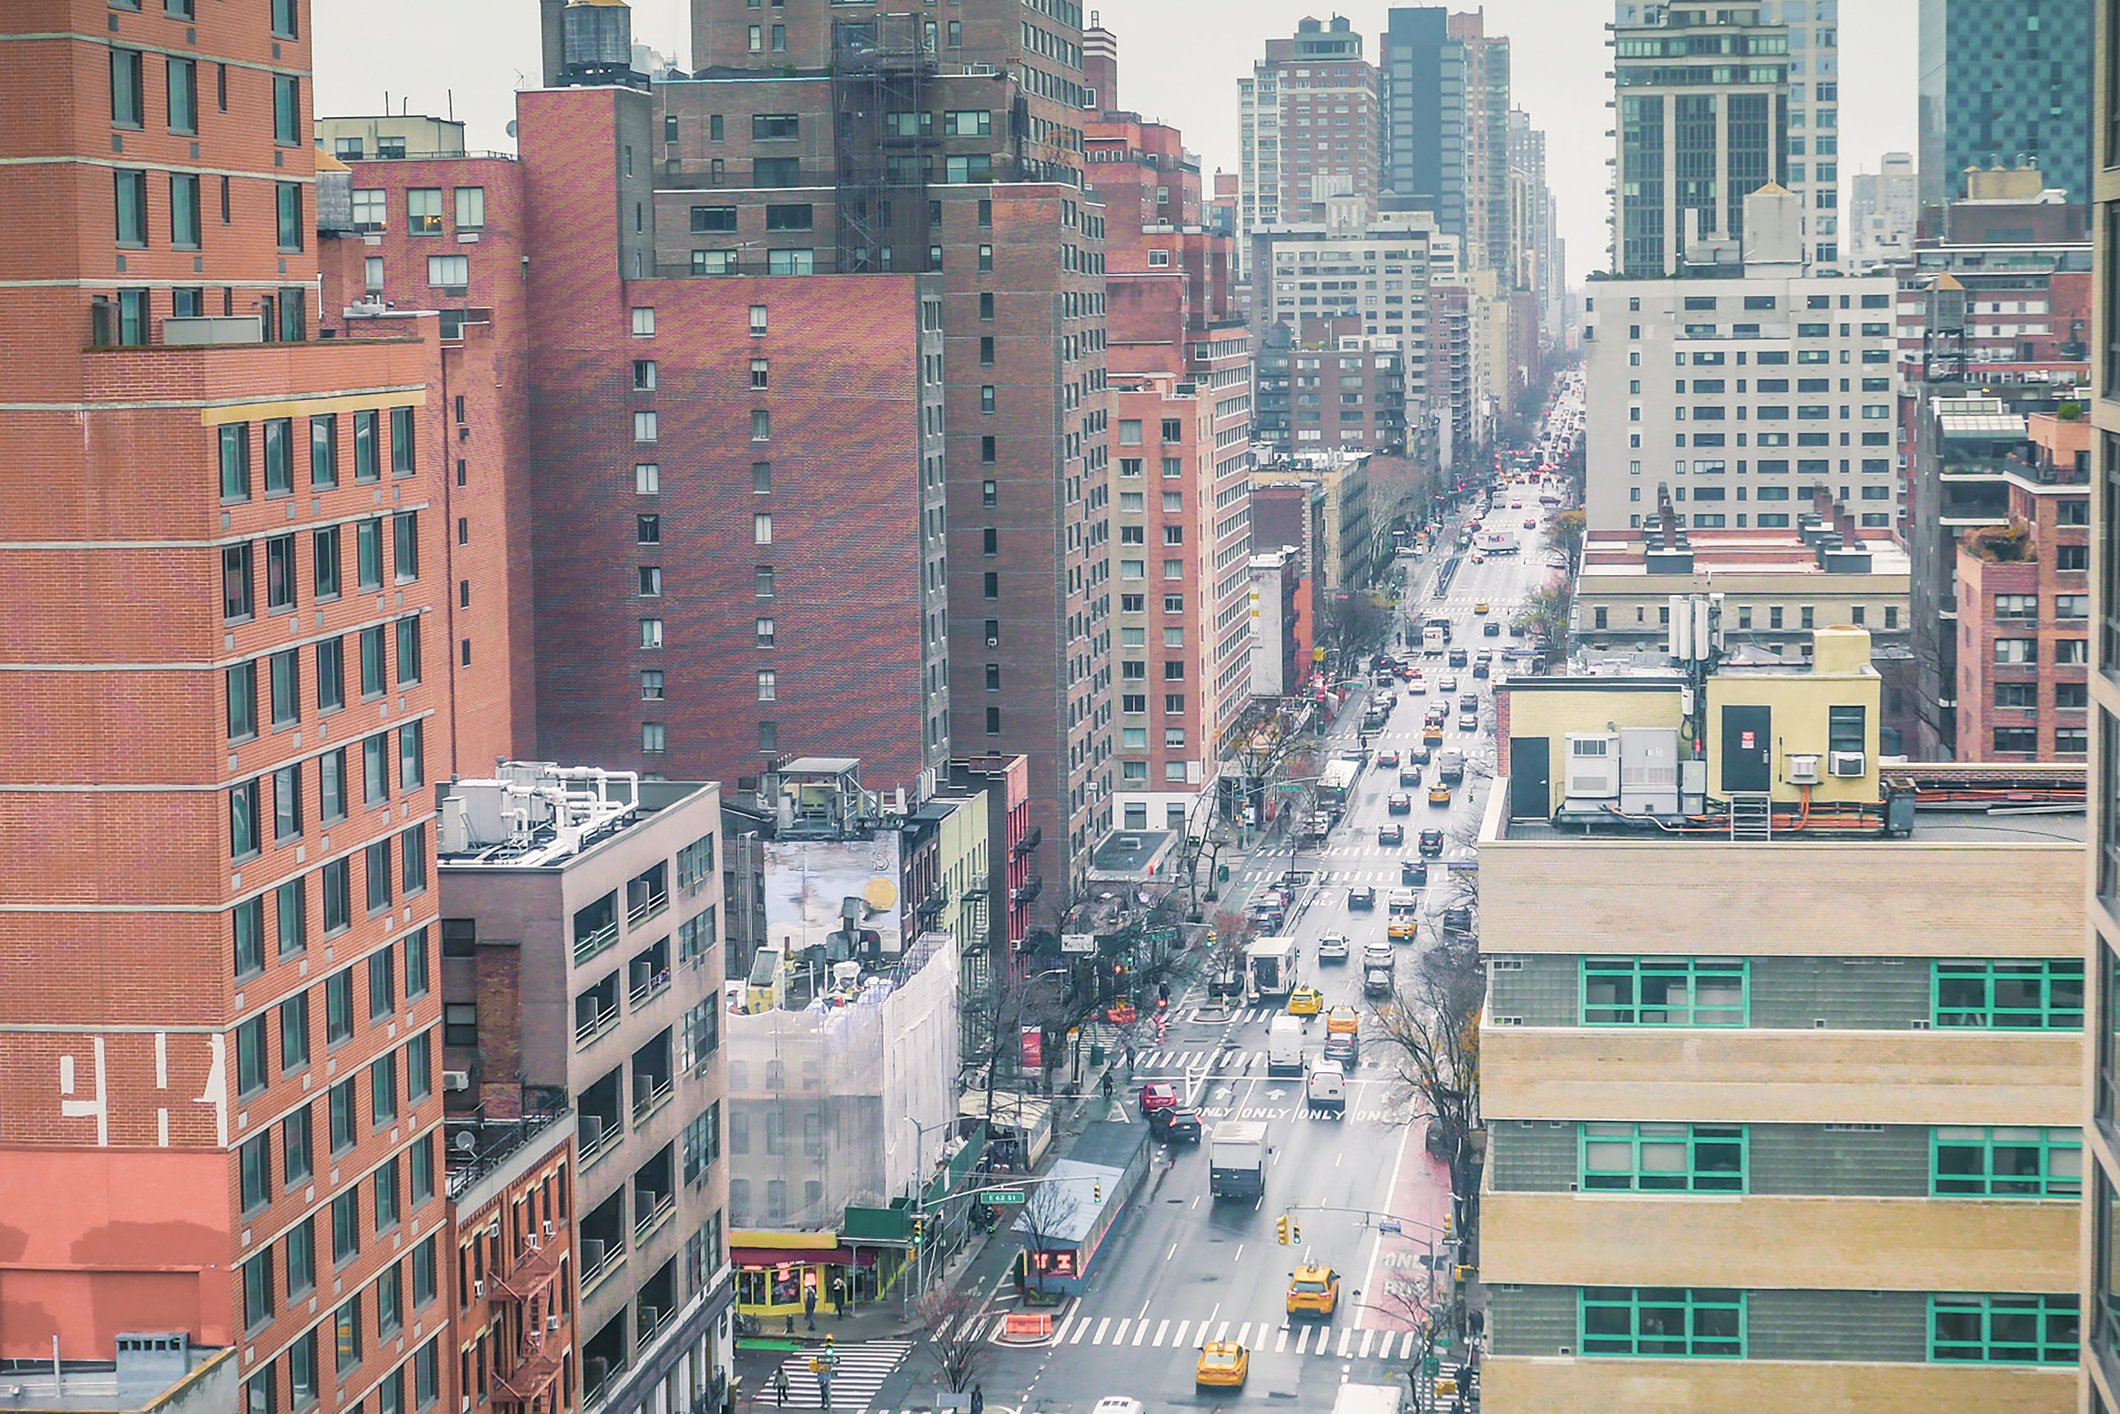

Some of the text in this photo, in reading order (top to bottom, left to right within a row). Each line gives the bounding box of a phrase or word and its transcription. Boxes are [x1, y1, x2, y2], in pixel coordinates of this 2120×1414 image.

[1193, 1107, 1234, 1117] ONLY
[1241, 1108, 1291, 1119] ONLY
[1298, 1108, 1346, 1121] ONLY
